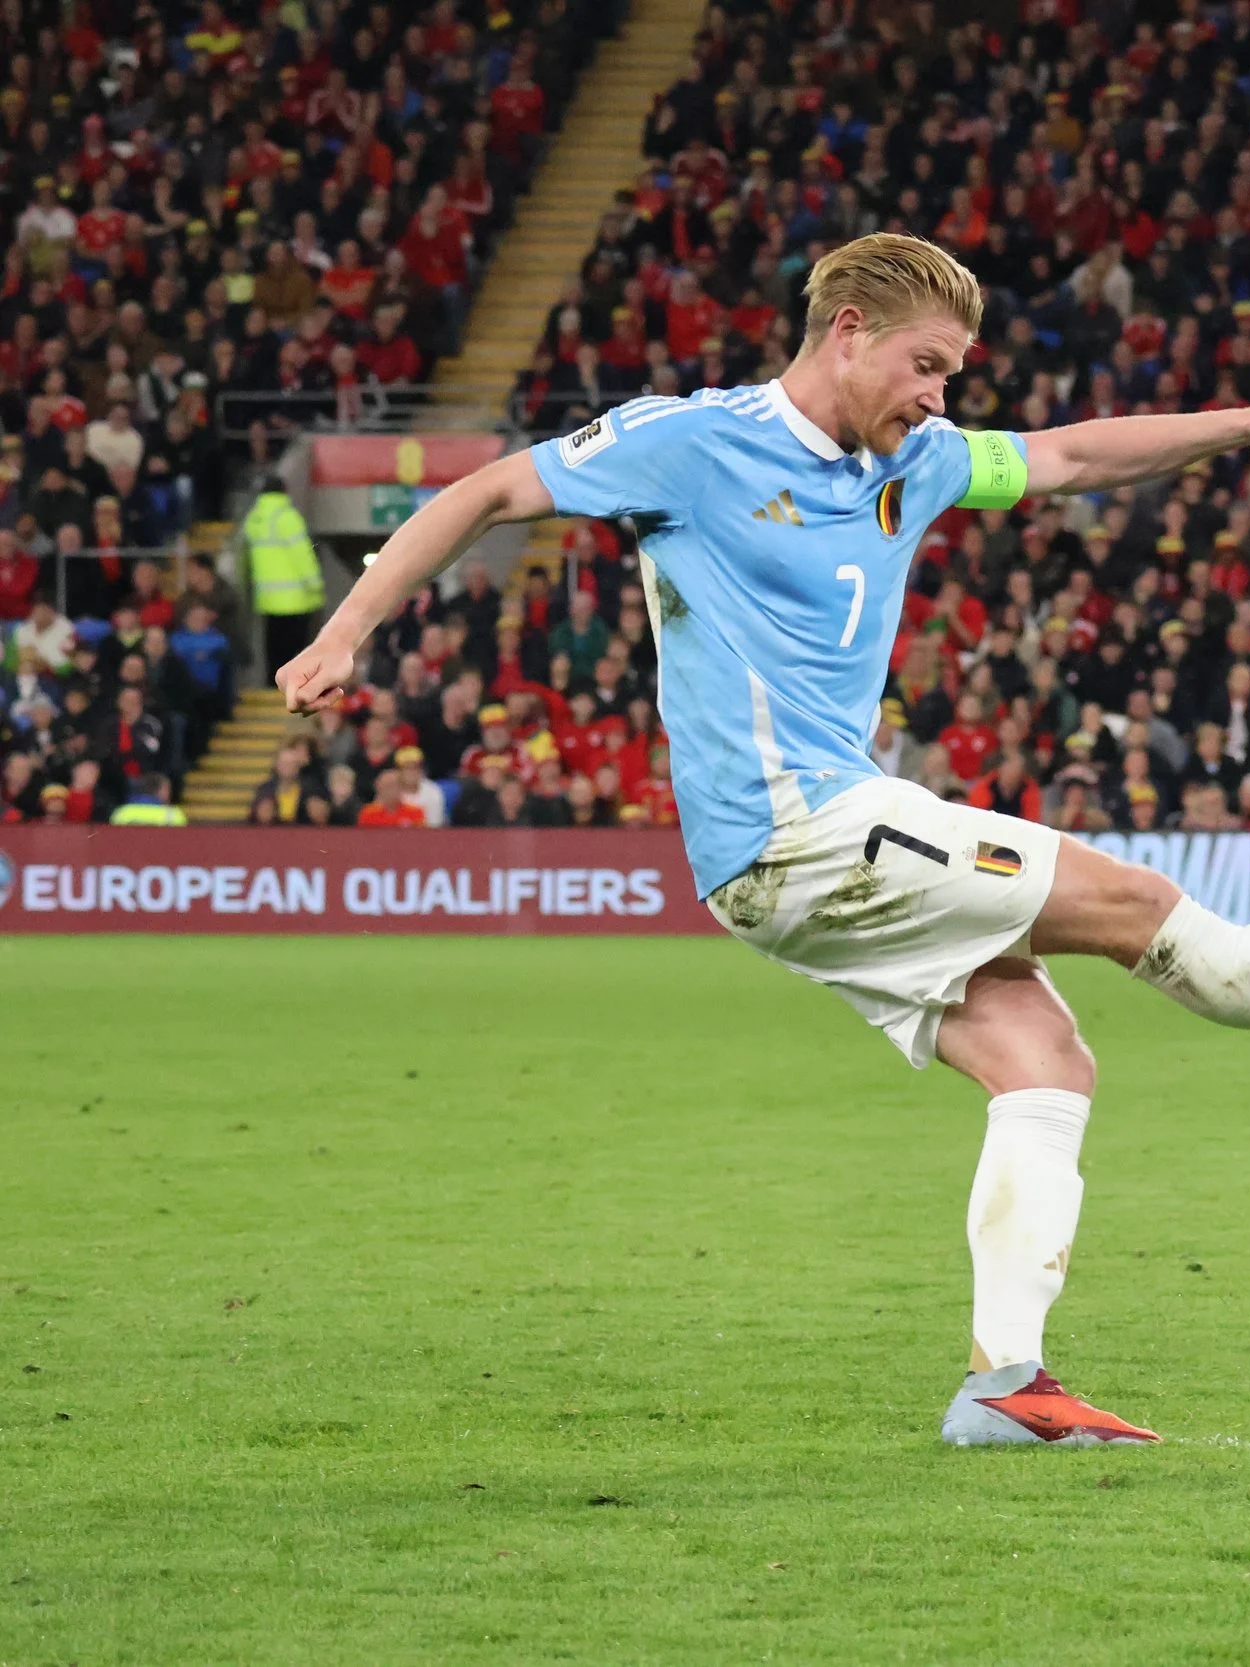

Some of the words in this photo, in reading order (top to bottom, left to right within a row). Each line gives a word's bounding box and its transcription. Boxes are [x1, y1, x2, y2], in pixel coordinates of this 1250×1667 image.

[835, 563, 866, 648] 7
[863, 823, 950, 868] 7
[23, 865, 325, 915] EUROPEAN
[343, 867, 665, 916] QUALIFIERS
